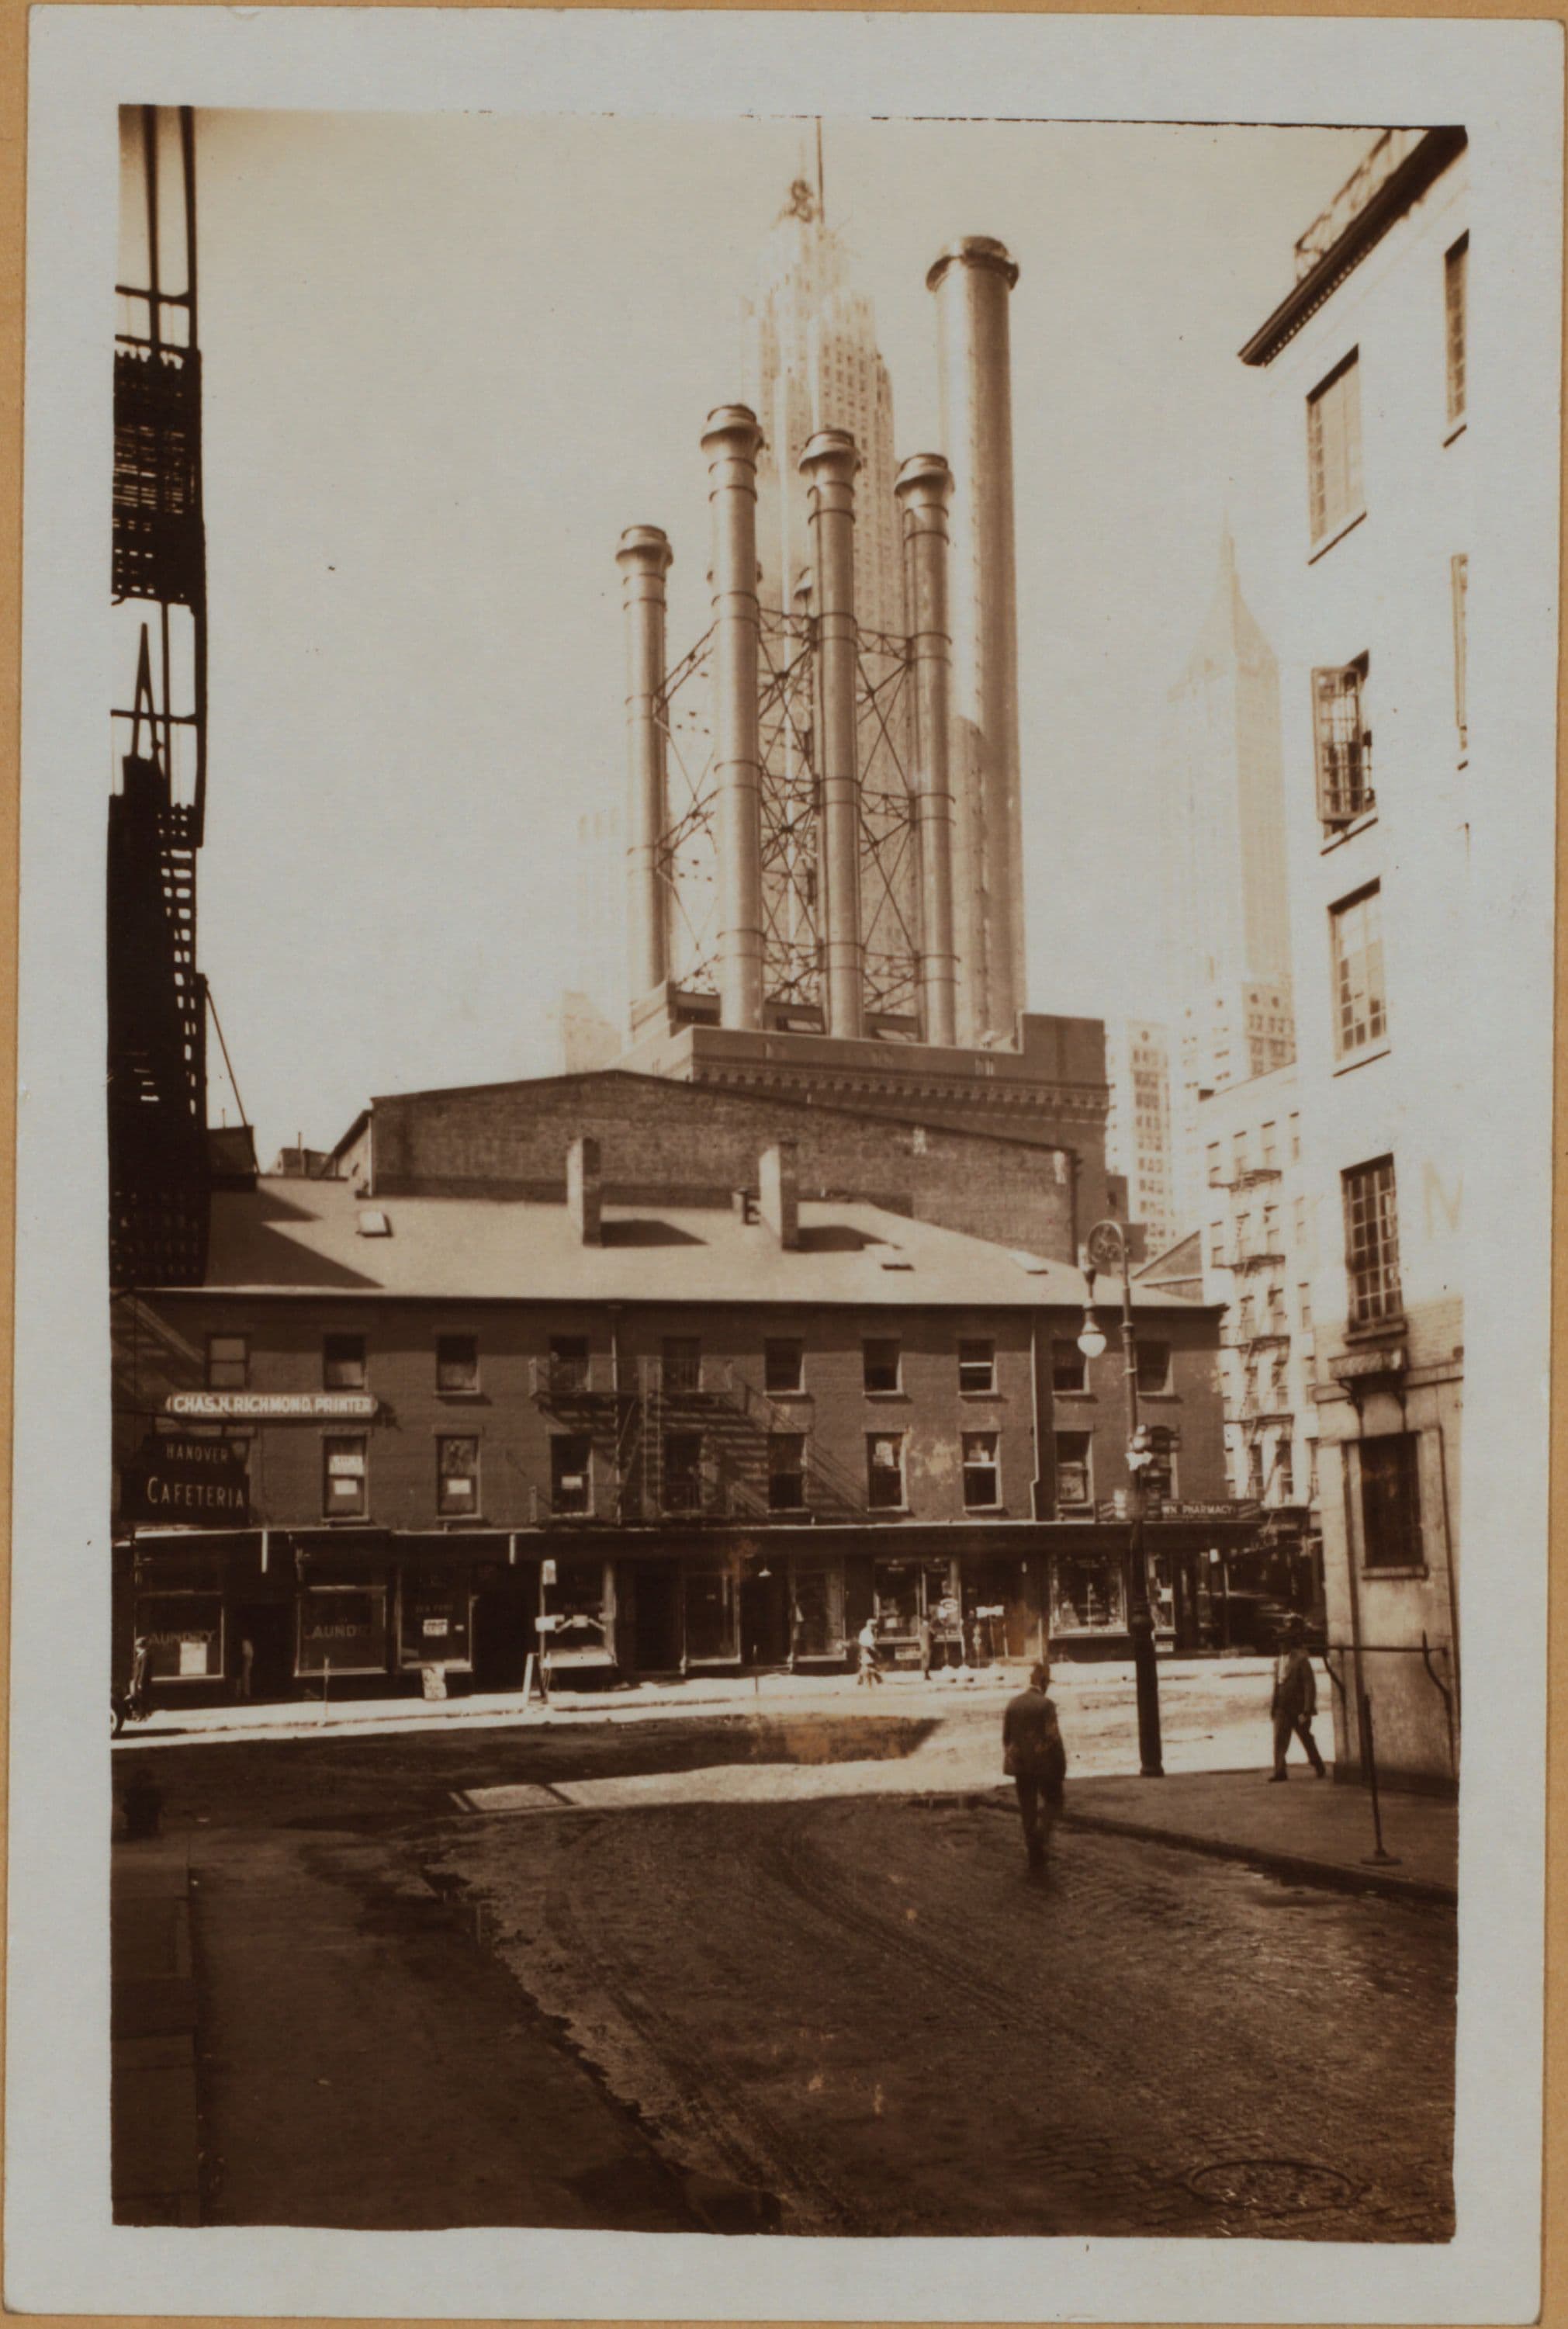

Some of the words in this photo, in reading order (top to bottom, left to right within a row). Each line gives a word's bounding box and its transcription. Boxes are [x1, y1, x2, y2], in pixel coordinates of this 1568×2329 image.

[315, 1395, 372, 1412] PRINTER
[165, 1443, 229, 1464] HANOVER
[1182, 1504, 1232, 1515] PHARMACY
[303, 1624, 372, 1640] LAUND
